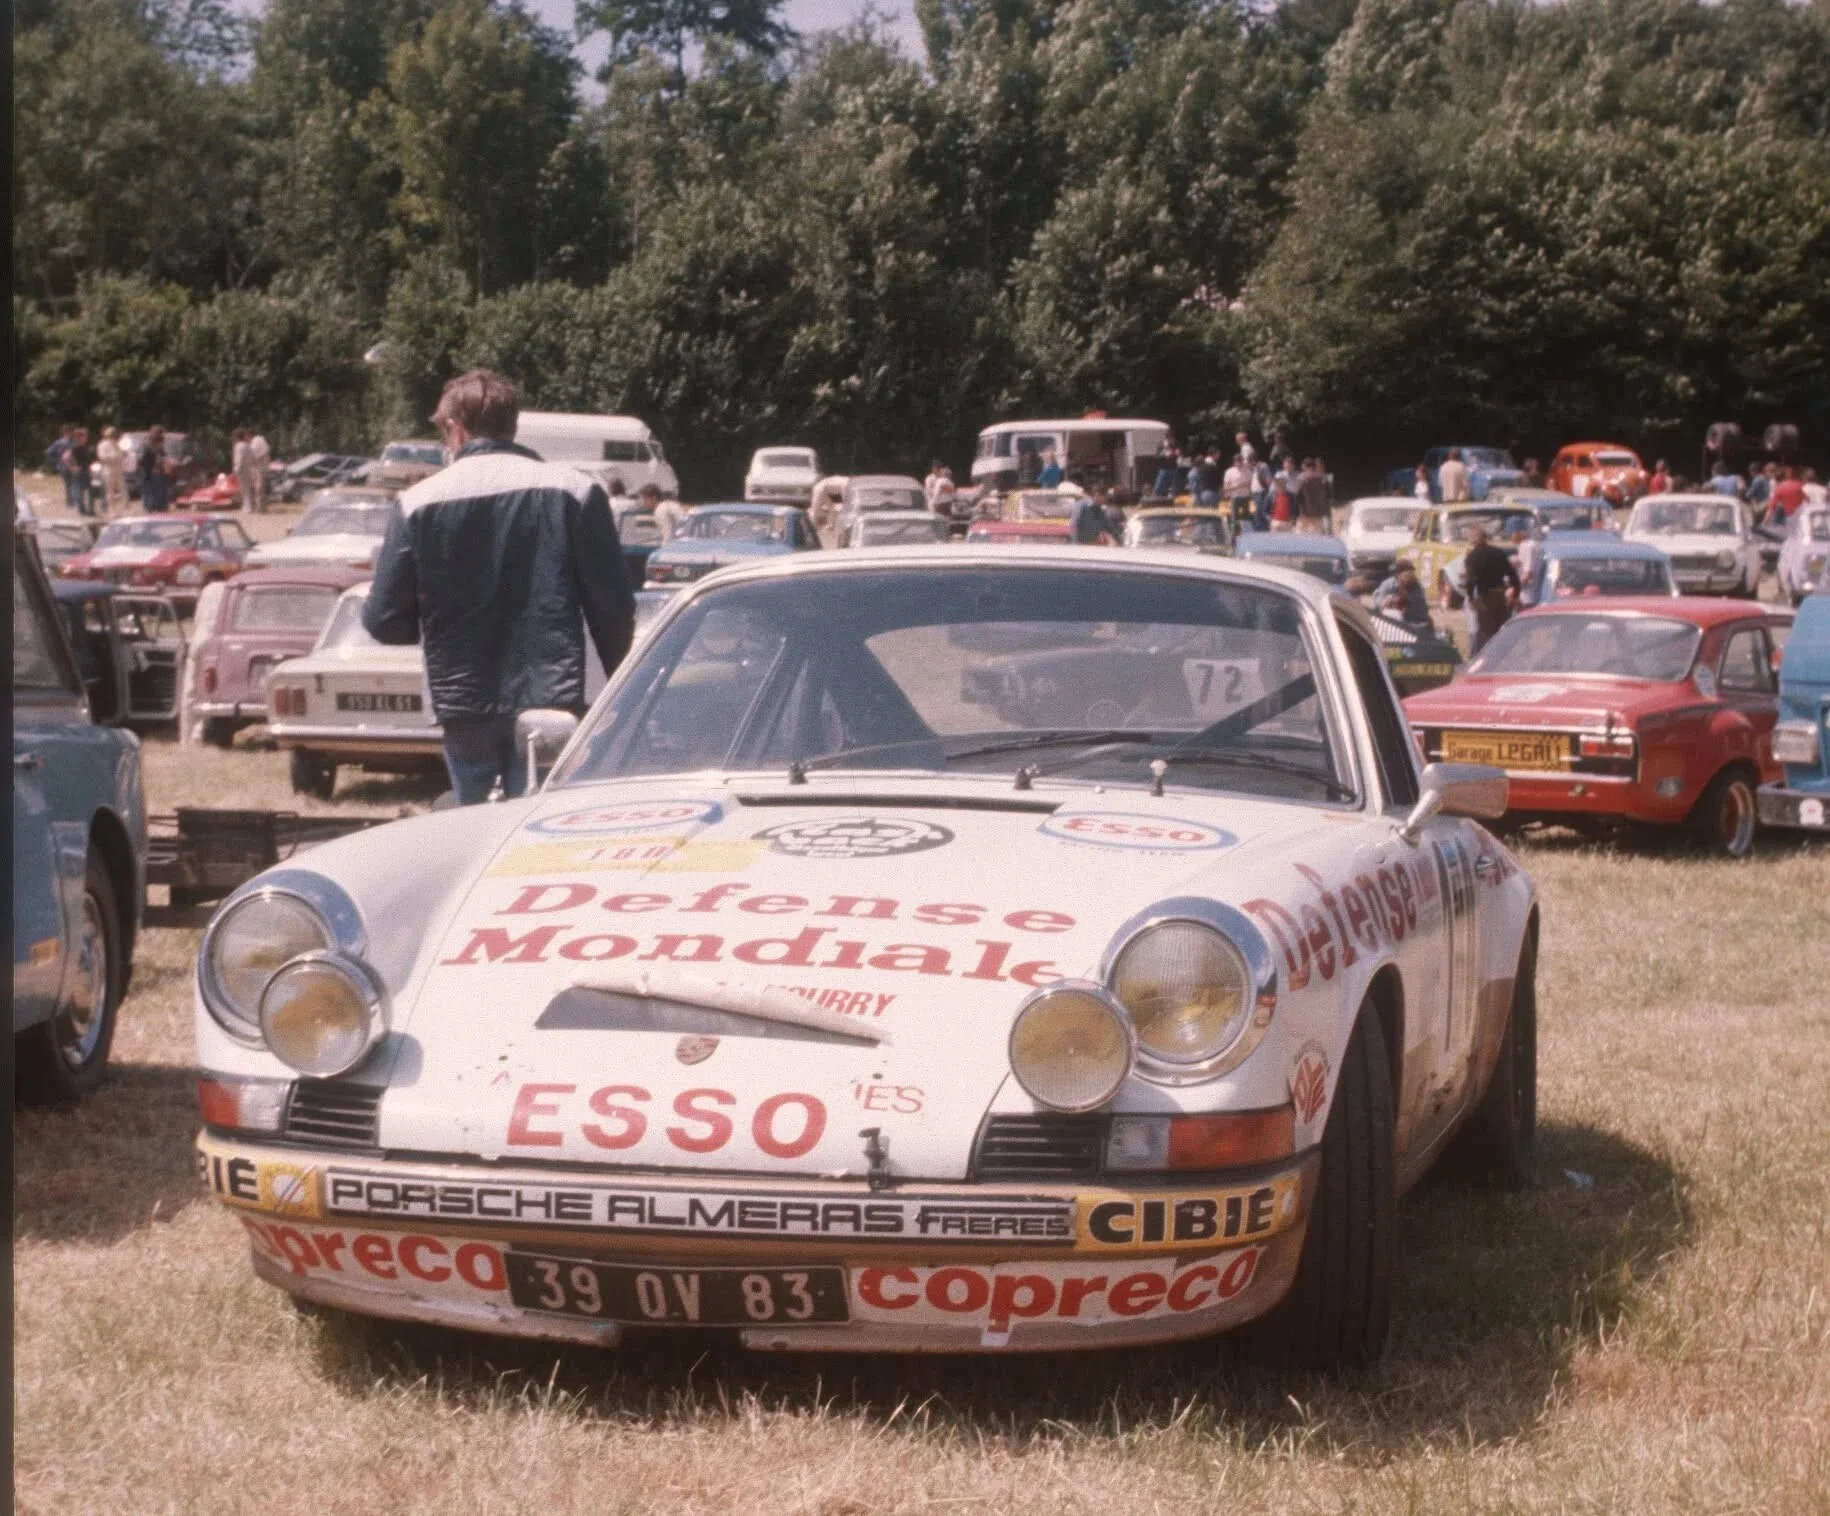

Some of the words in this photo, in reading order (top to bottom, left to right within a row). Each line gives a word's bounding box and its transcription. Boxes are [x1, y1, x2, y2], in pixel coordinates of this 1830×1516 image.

[1195, 663, 1242, 705] 72
[1447, 741, 1494, 764] Garage
[492, 881, 1077, 934] Defense
[440, 924, 1065, 989] Mondiale
[506, 1083, 828, 1160] ESSO
[332, 1178, 593, 1221] PORSCHE
[607, 1194, 904, 1233] ALMERAS
[915, 1204, 1070, 1236] FRERES
[535, 1260, 602, 1313] 39
[741, 1272, 815, 1321] 83
[857, 1247, 1260, 1334] copreco
